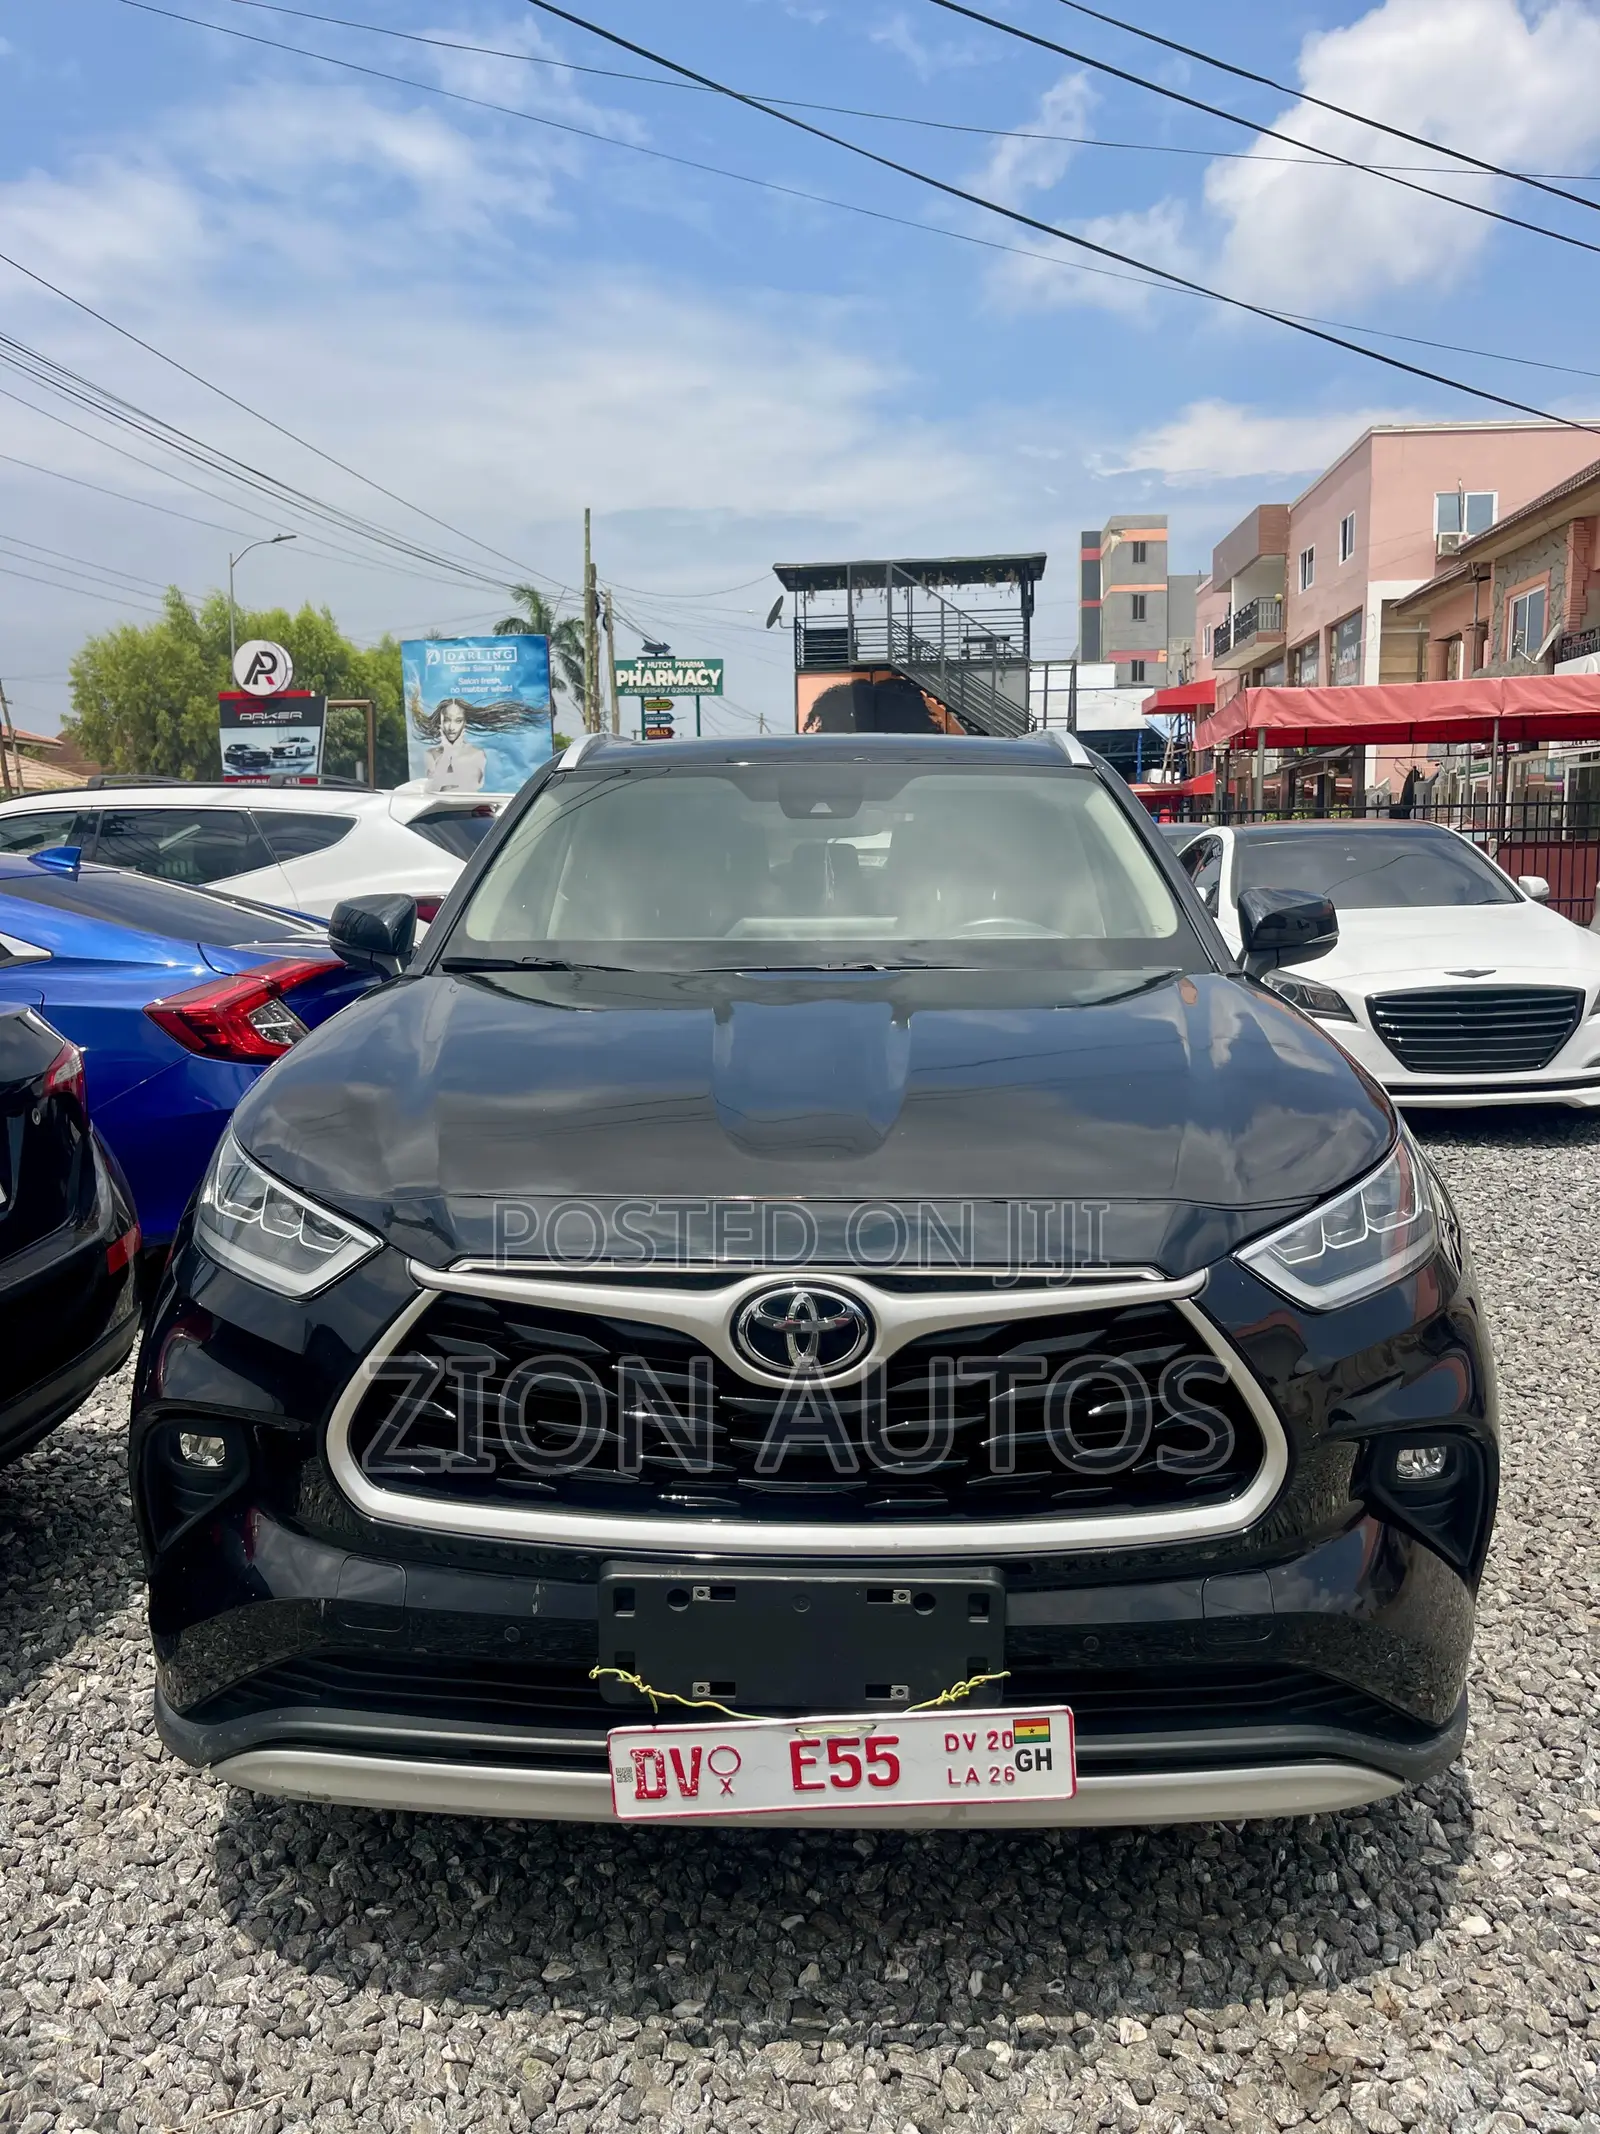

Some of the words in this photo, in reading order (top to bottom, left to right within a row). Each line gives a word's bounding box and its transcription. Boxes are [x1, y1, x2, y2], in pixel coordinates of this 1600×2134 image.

[447, 650, 513, 660] DARLING
[458, 677, 480, 685] Salon
[616, 669, 722, 687] PHARMACY
[944, 1732, 977, 1752] DV
[986, 1729, 1014, 1751] 20
[630, 1746, 703, 1800] DV
[789, 1736, 900, 1790] E55
[1014, 1747, 1053, 1773] GH
[947, 1766, 981, 1786] LA
[988, 1764, 1016, 1784] 26
